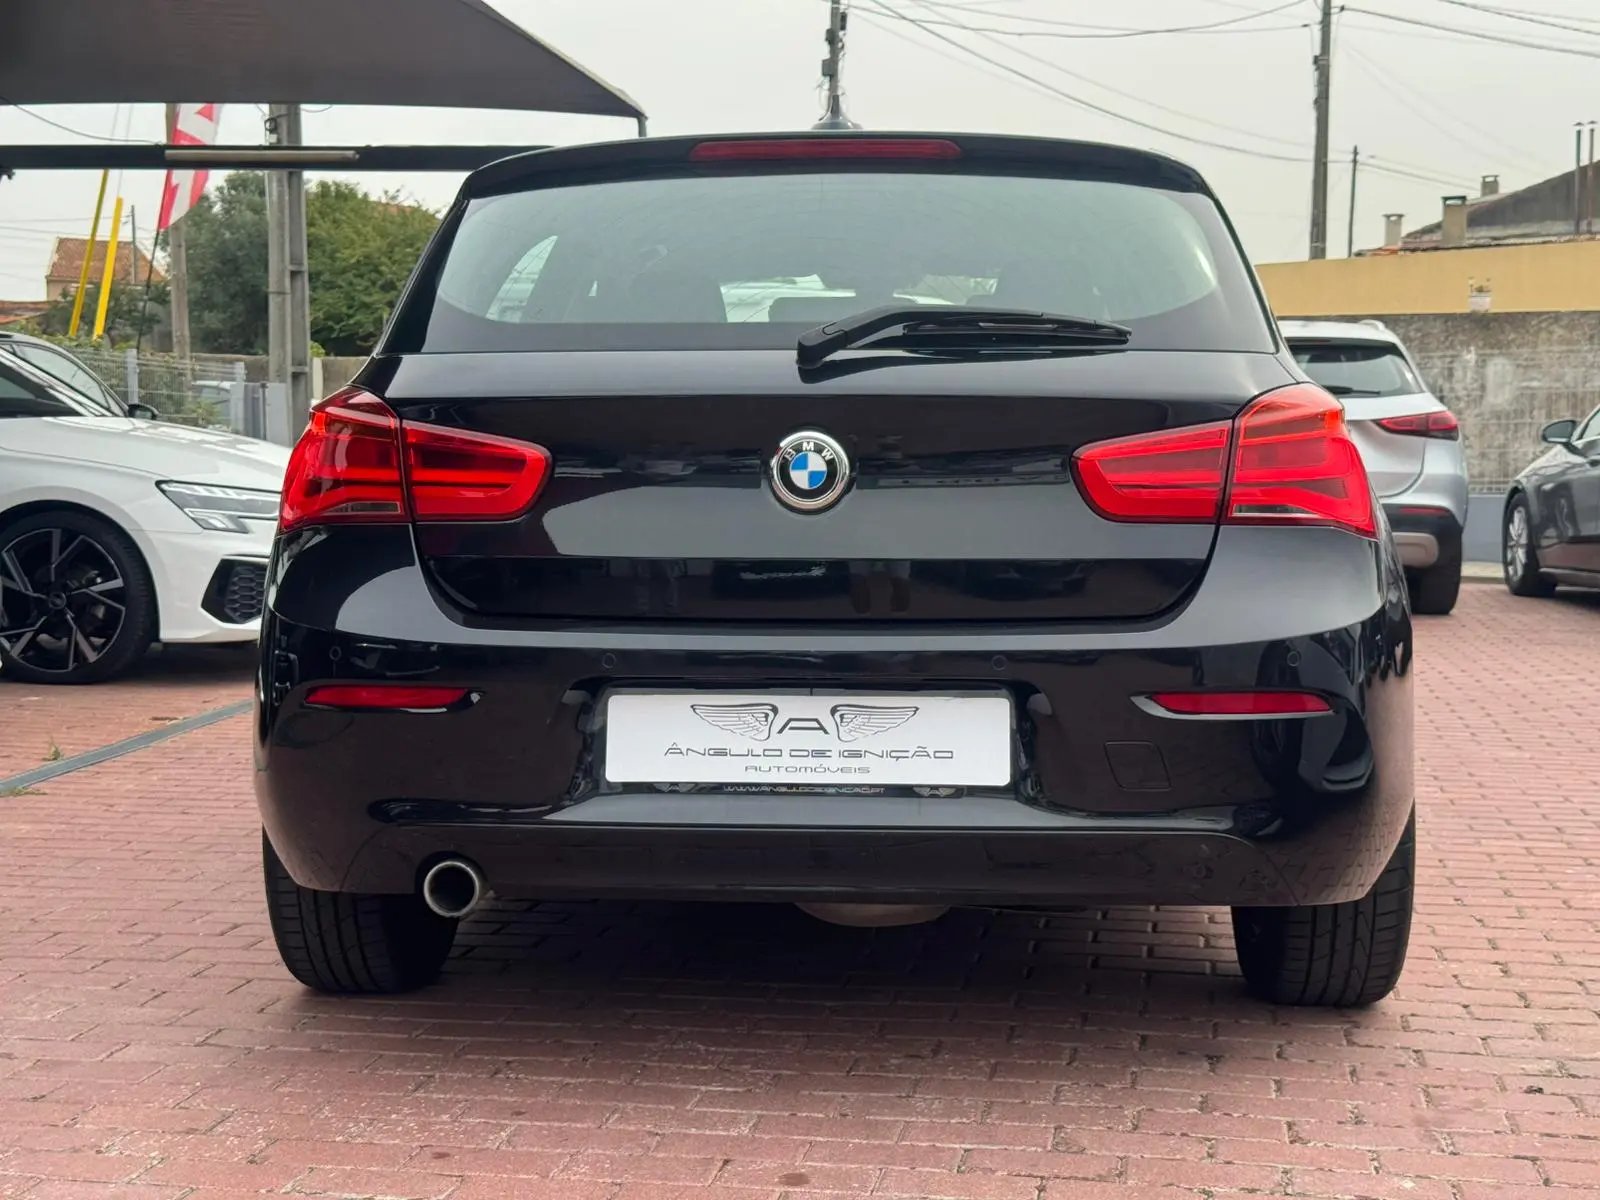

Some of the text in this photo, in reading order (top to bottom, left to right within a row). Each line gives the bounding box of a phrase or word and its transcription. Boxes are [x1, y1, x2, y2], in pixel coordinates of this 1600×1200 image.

[784, 441, 834, 461] BMW
[776, 718, 830, 735] A
[664, 742, 954, 762] ÂNGULO DE IGNIÇÃO
[745, 764, 870, 774] AUTOMÓVEIS
